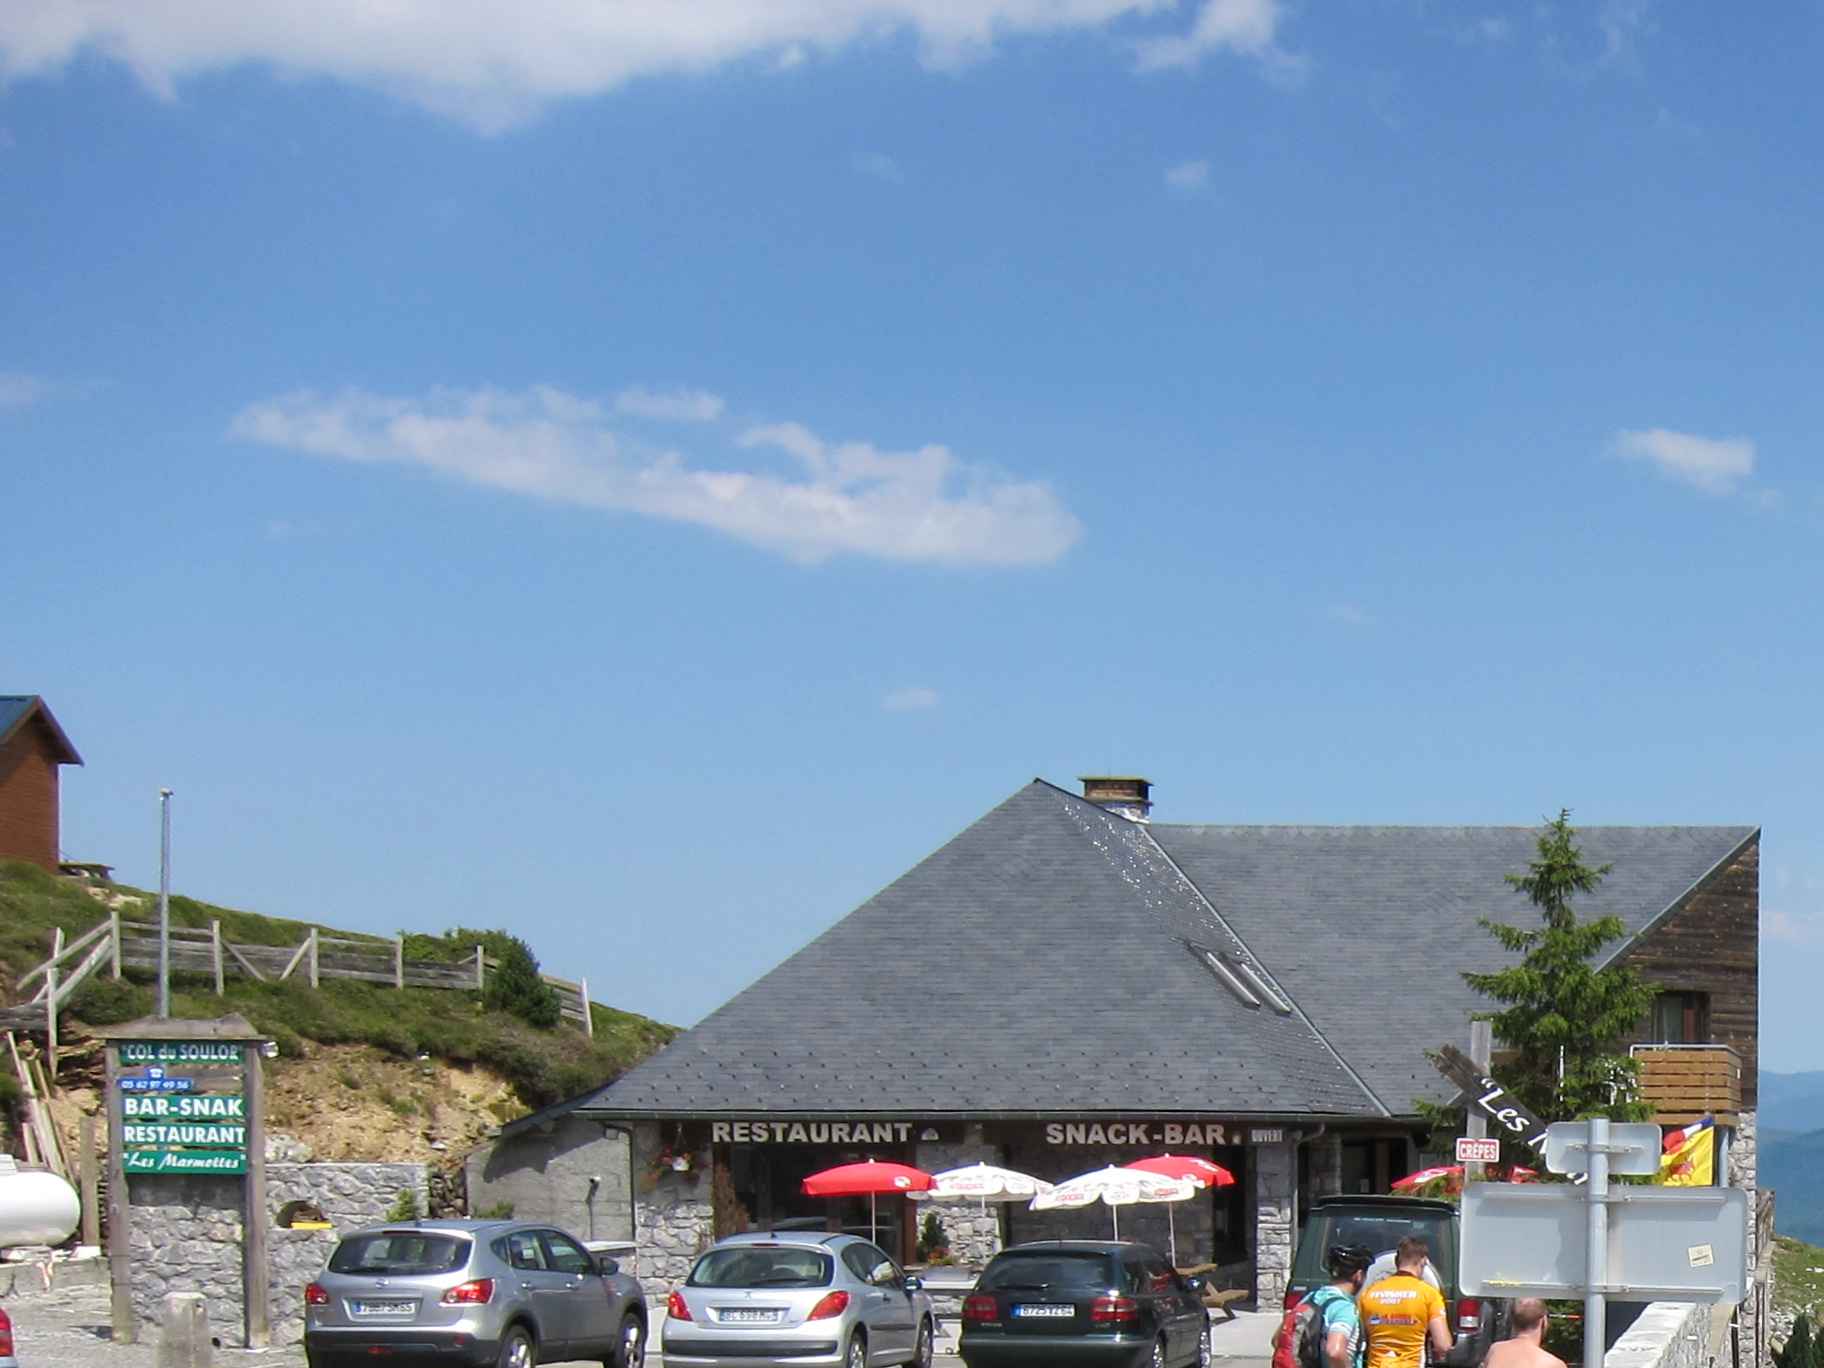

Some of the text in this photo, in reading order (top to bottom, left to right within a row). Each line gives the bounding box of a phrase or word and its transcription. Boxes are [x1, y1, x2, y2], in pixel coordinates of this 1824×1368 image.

[158, 1043, 176, 1060] du
[124, 1097, 244, 1117] BAR-SNAK
[123, 1125, 246, 1144] RESTAURANT
[712, 1121, 913, 1144] RESTAURANT
